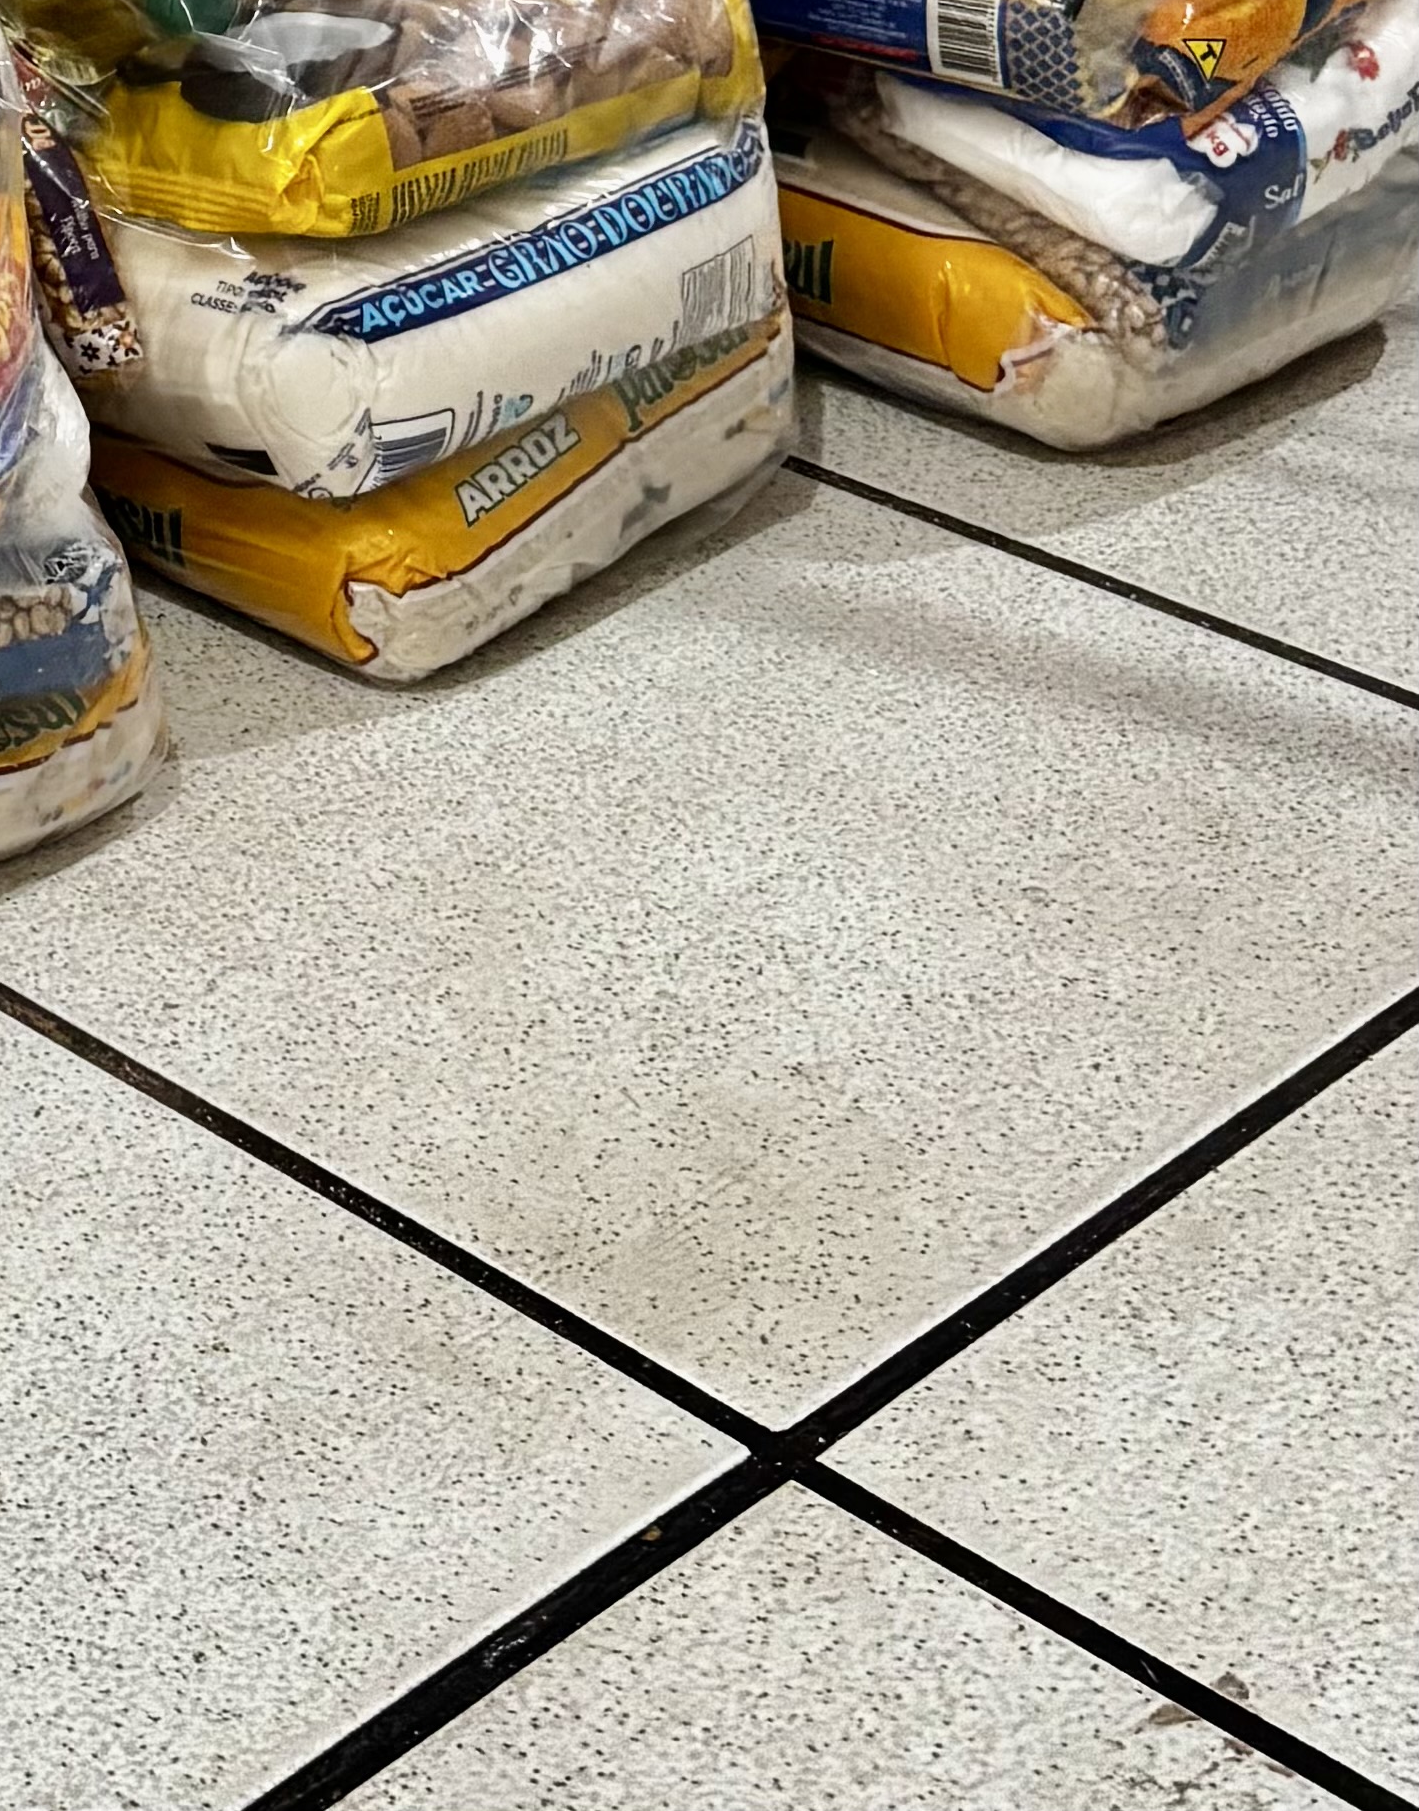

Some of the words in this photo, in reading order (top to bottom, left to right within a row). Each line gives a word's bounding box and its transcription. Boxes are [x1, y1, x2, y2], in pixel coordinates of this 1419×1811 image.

[1264, 172, 1304, 210] Sal
[362, 267, 481, 333] AÇÚCAR
[489, 215, 599, 290] GRÃO
[454, 411, 582, 529] ARROZ
